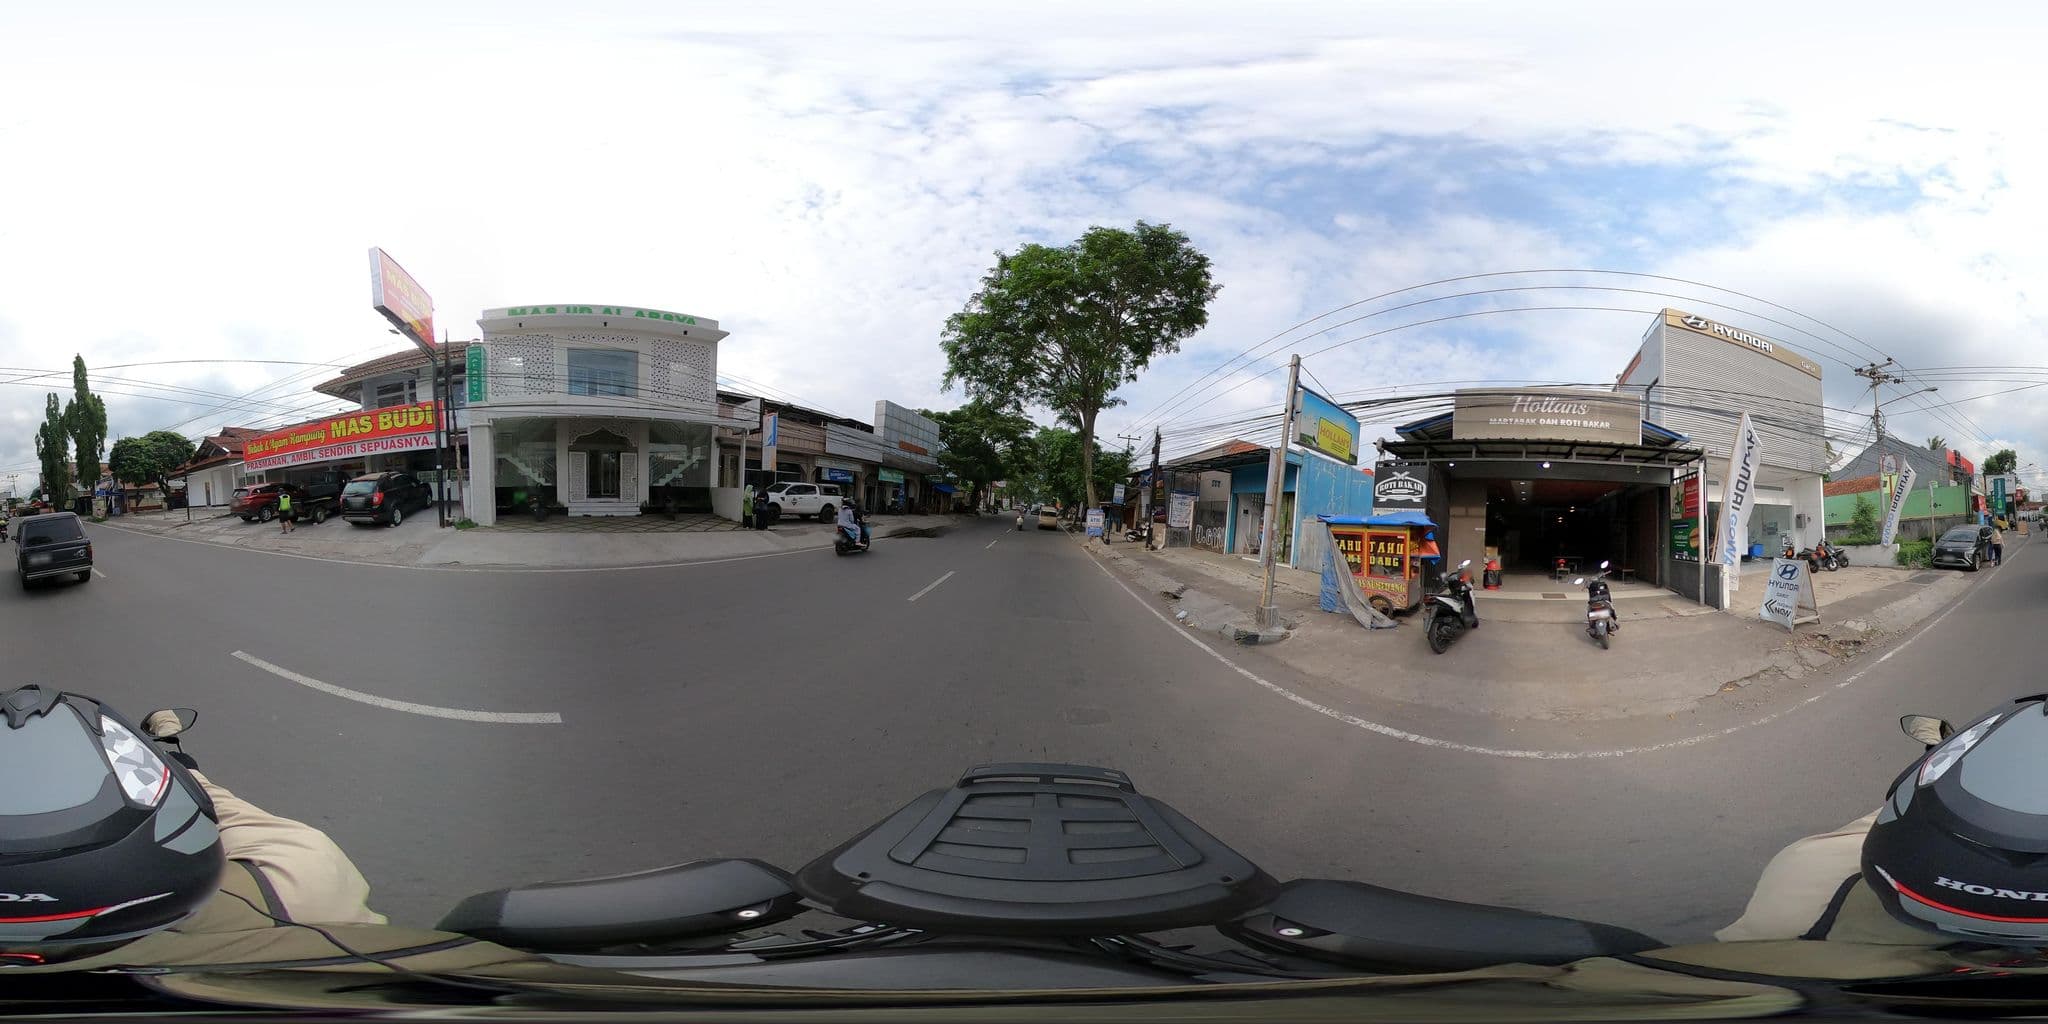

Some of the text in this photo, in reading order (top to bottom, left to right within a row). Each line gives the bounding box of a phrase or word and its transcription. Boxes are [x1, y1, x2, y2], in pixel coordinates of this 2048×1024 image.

[1713, 323, 1773, 354] HYUNDAI
[290, 428, 326, 445] Kampung
[331, 415, 373, 439] MAS
[378, 404, 433, 431] BUDI
[1489, 417, 1610, 430] MARTABAK DAN ROTI BAKAR
[291, 452, 316, 463] AMBIL
[318, 445, 357, 458] SENDIRI
[1380, 481, 1422, 492] ROTI BAKAR
[1890, 467, 1912, 513] HYUNDAI
[1723, 429, 1757, 567] HYUNDAI GOWA
[1369, 541, 1405, 555] TAHU
[1369, 557, 1399, 567] DANG
[1768, 579, 1799, 591] HYUNDA
[1774, 607, 1792, 618] NOW
